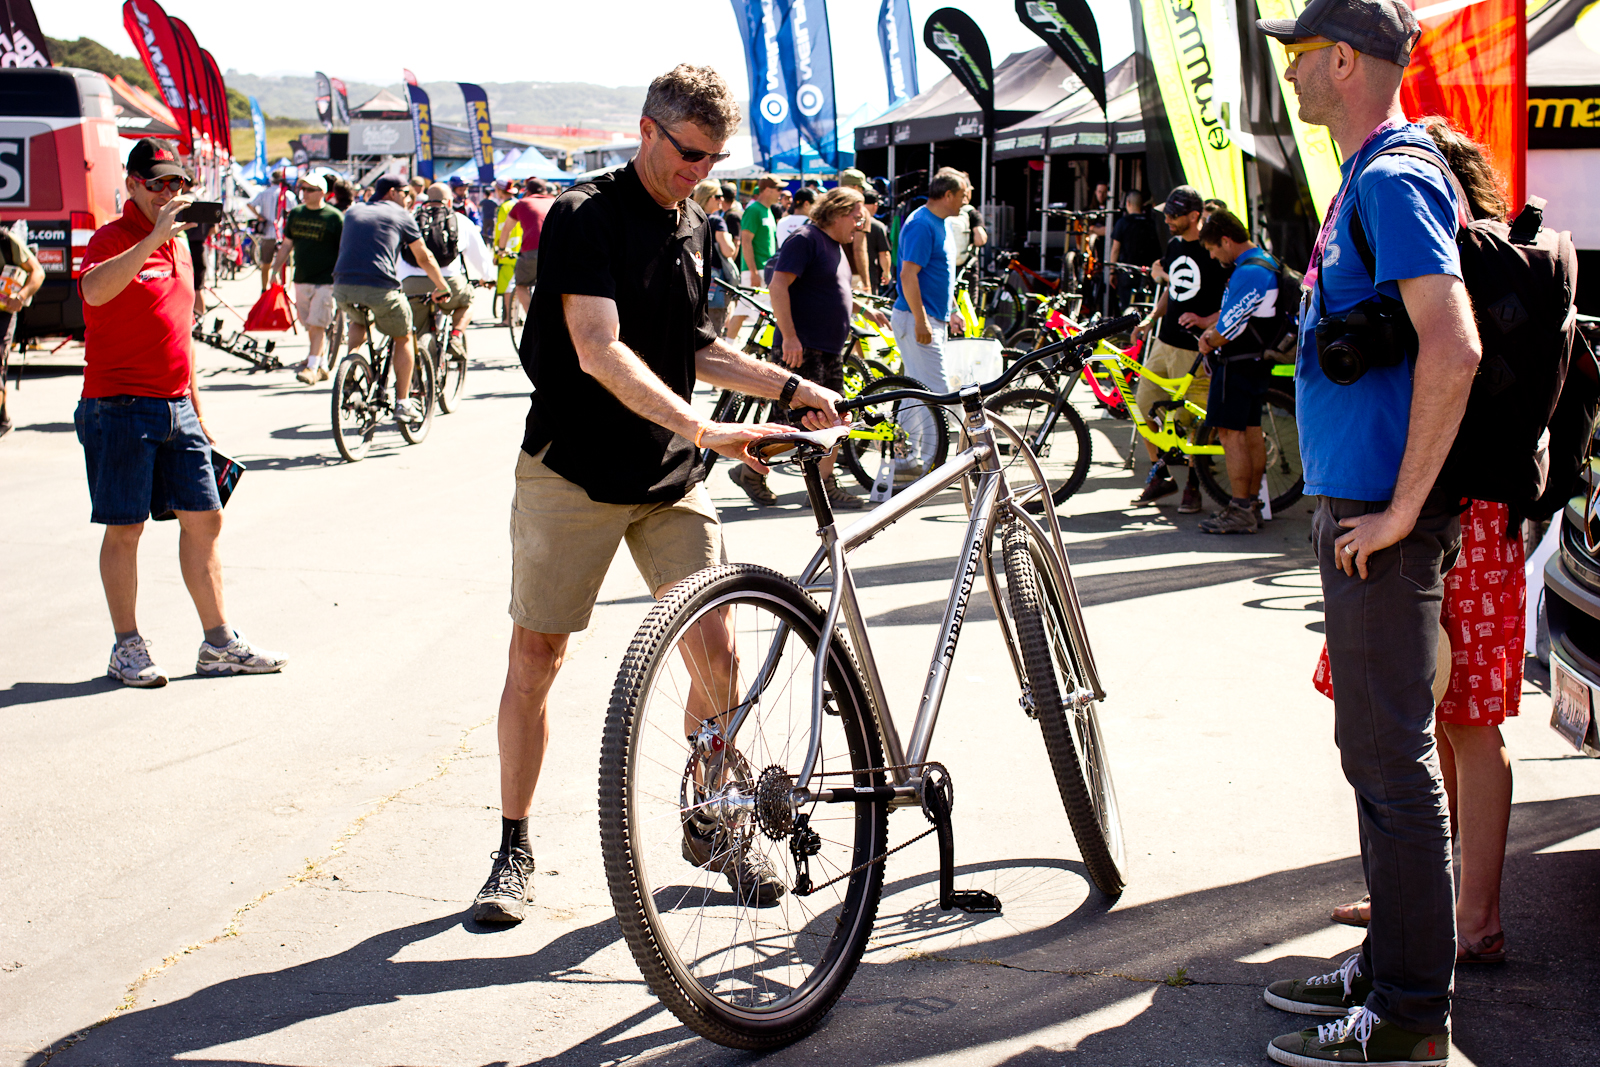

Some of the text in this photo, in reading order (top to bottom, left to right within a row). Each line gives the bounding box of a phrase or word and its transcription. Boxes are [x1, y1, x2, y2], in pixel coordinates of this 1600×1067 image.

[131, 0, 185, 109] JAMIS
[418, 103, 432, 161] KHS
[475, 101, 494, 164] KHS
[1222, 288, 1258, 322] GRAVITY
